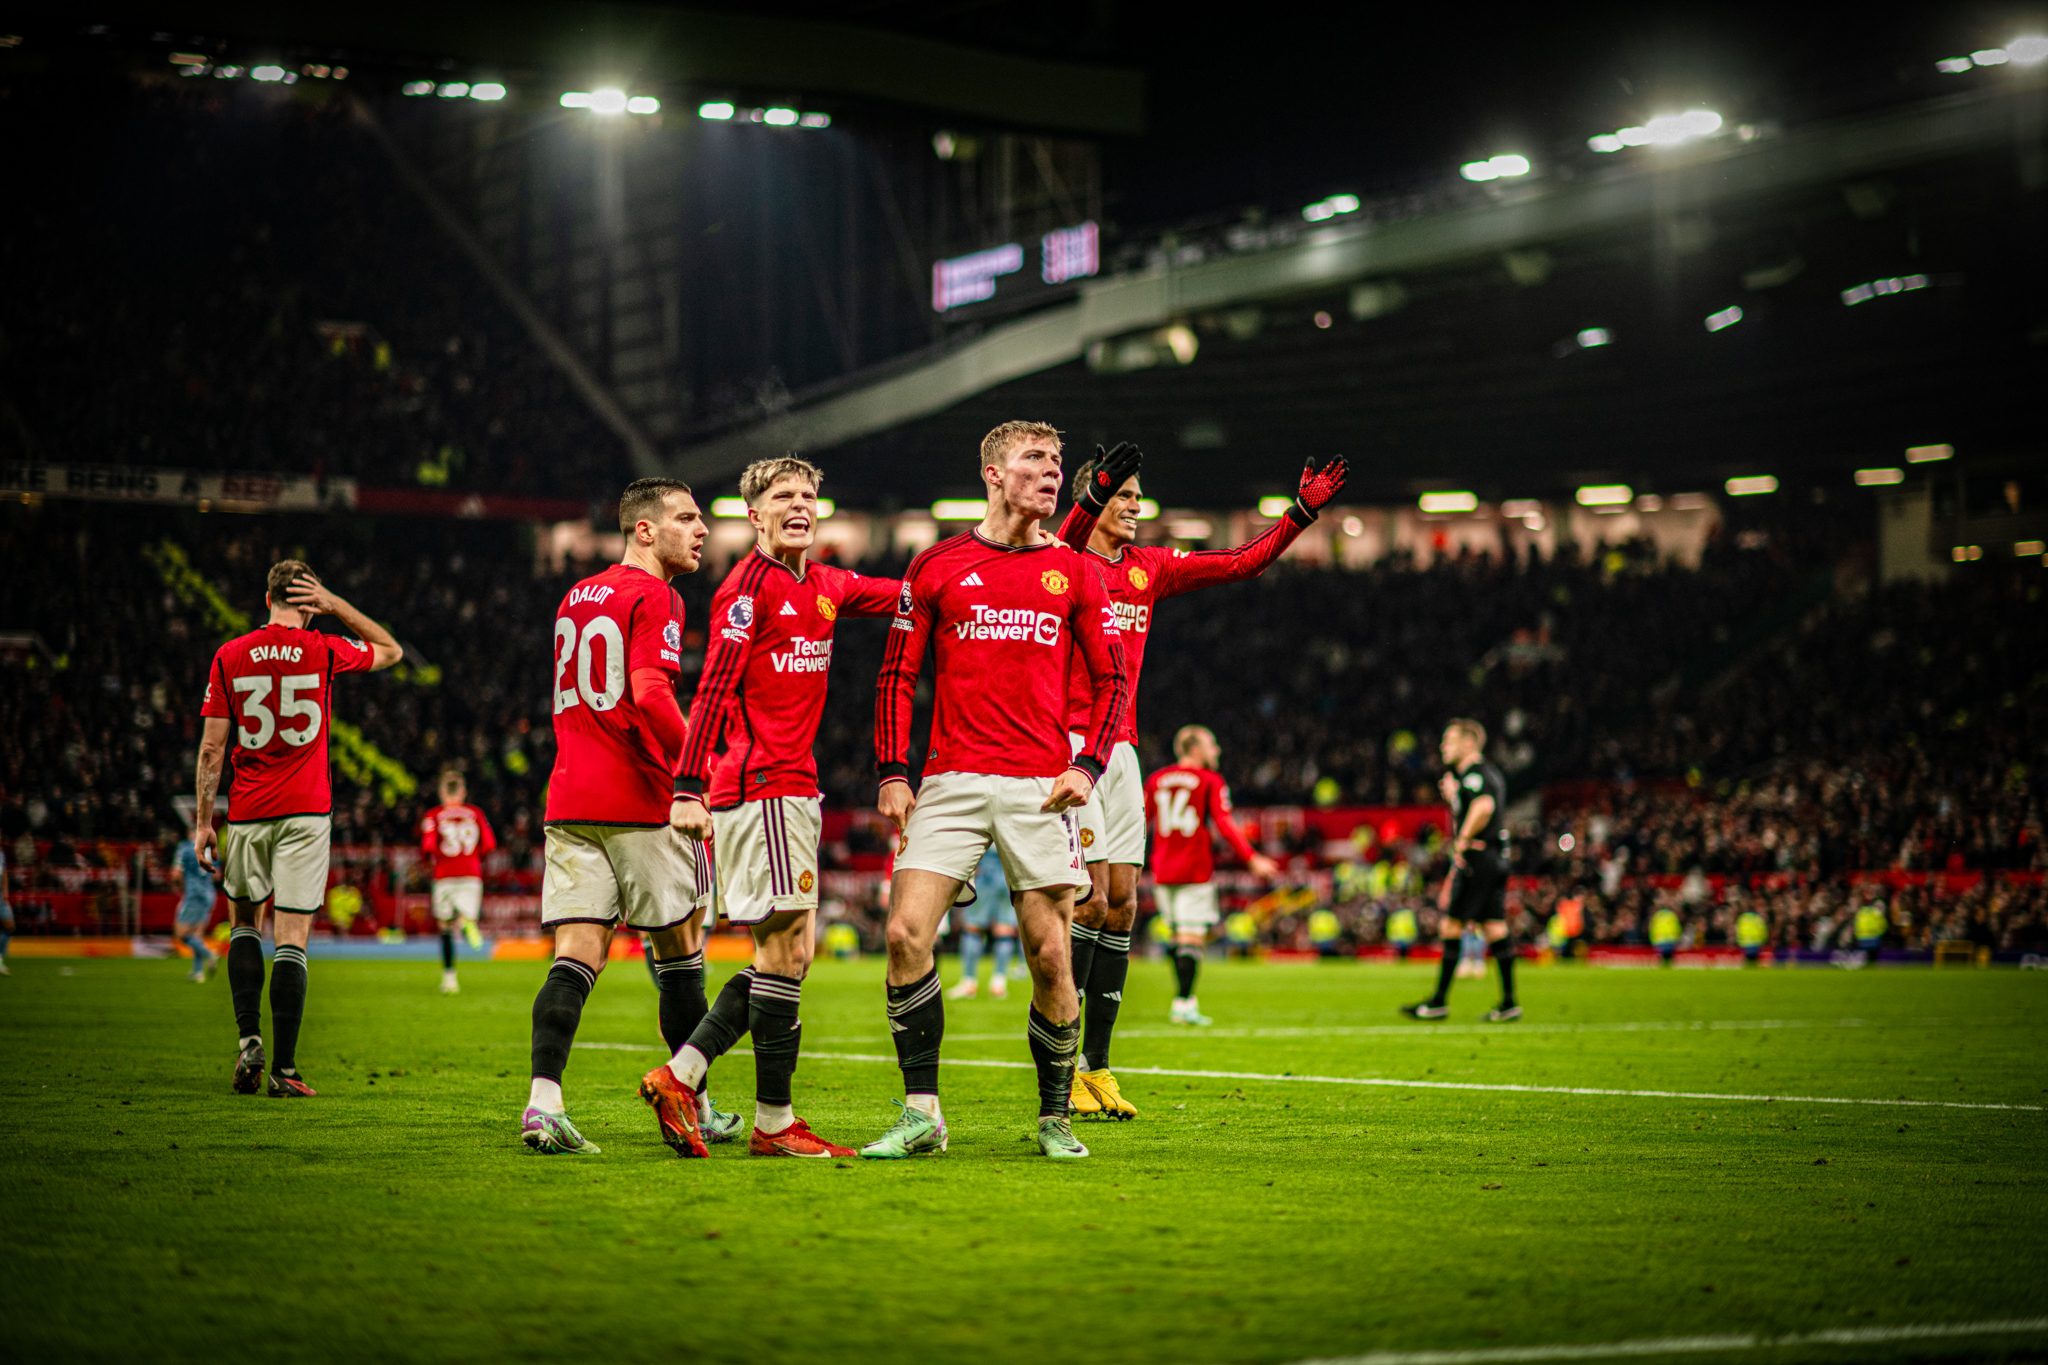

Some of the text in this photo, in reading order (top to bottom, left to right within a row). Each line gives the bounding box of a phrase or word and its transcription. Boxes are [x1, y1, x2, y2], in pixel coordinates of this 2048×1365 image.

[569, 584, 615, 608] DALOT
[970, 604, 1035, 626] Team
[954, 620, 1034, 641] Viewer
[249, 645, 303, 664] EVANS
[790, 636, 828, 657] Team
[554, 615, 626, 715] 20
[771, 652, 828, 673] Viewer
[232, 673, 322, 750] 35
[1154, 787, 1201, 838] 14
